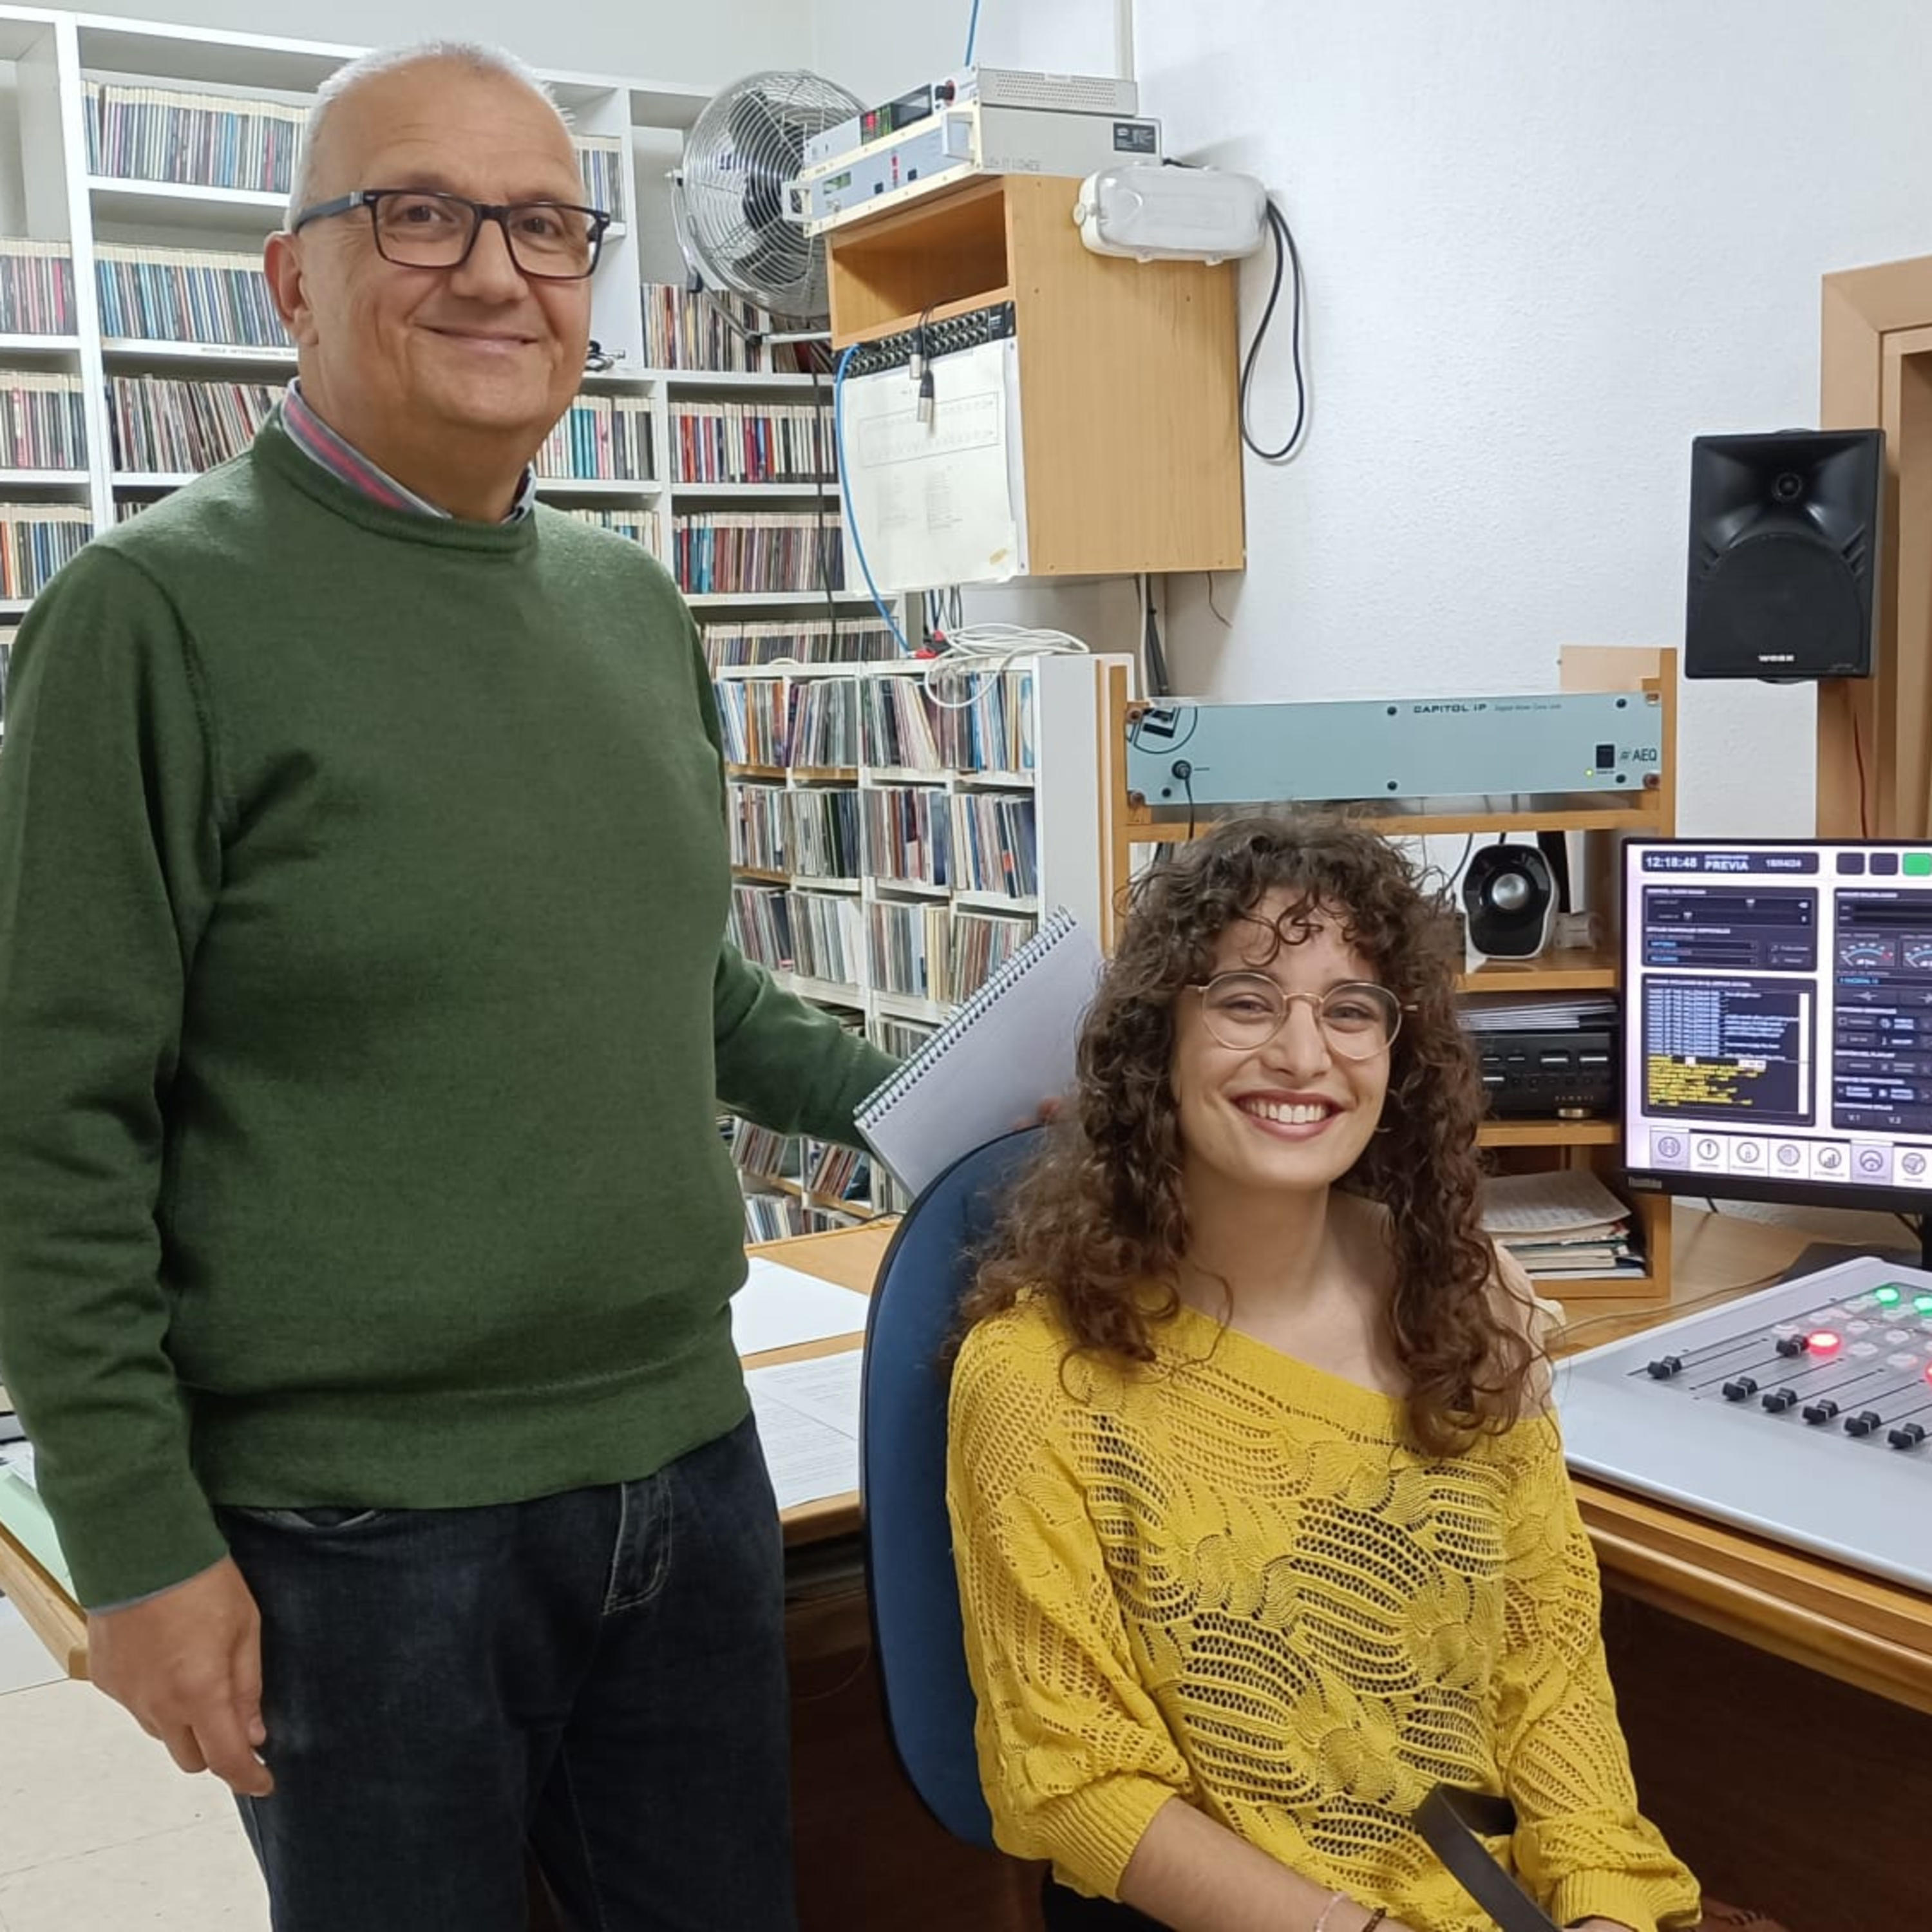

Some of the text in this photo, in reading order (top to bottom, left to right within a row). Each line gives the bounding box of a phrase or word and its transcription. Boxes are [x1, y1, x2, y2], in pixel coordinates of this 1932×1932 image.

[1414, 705, 1469, 714] CAPITOL
[1631, 748, 1658, 762] AEQ
[1704, 860, 1750, 871] PREVIA
